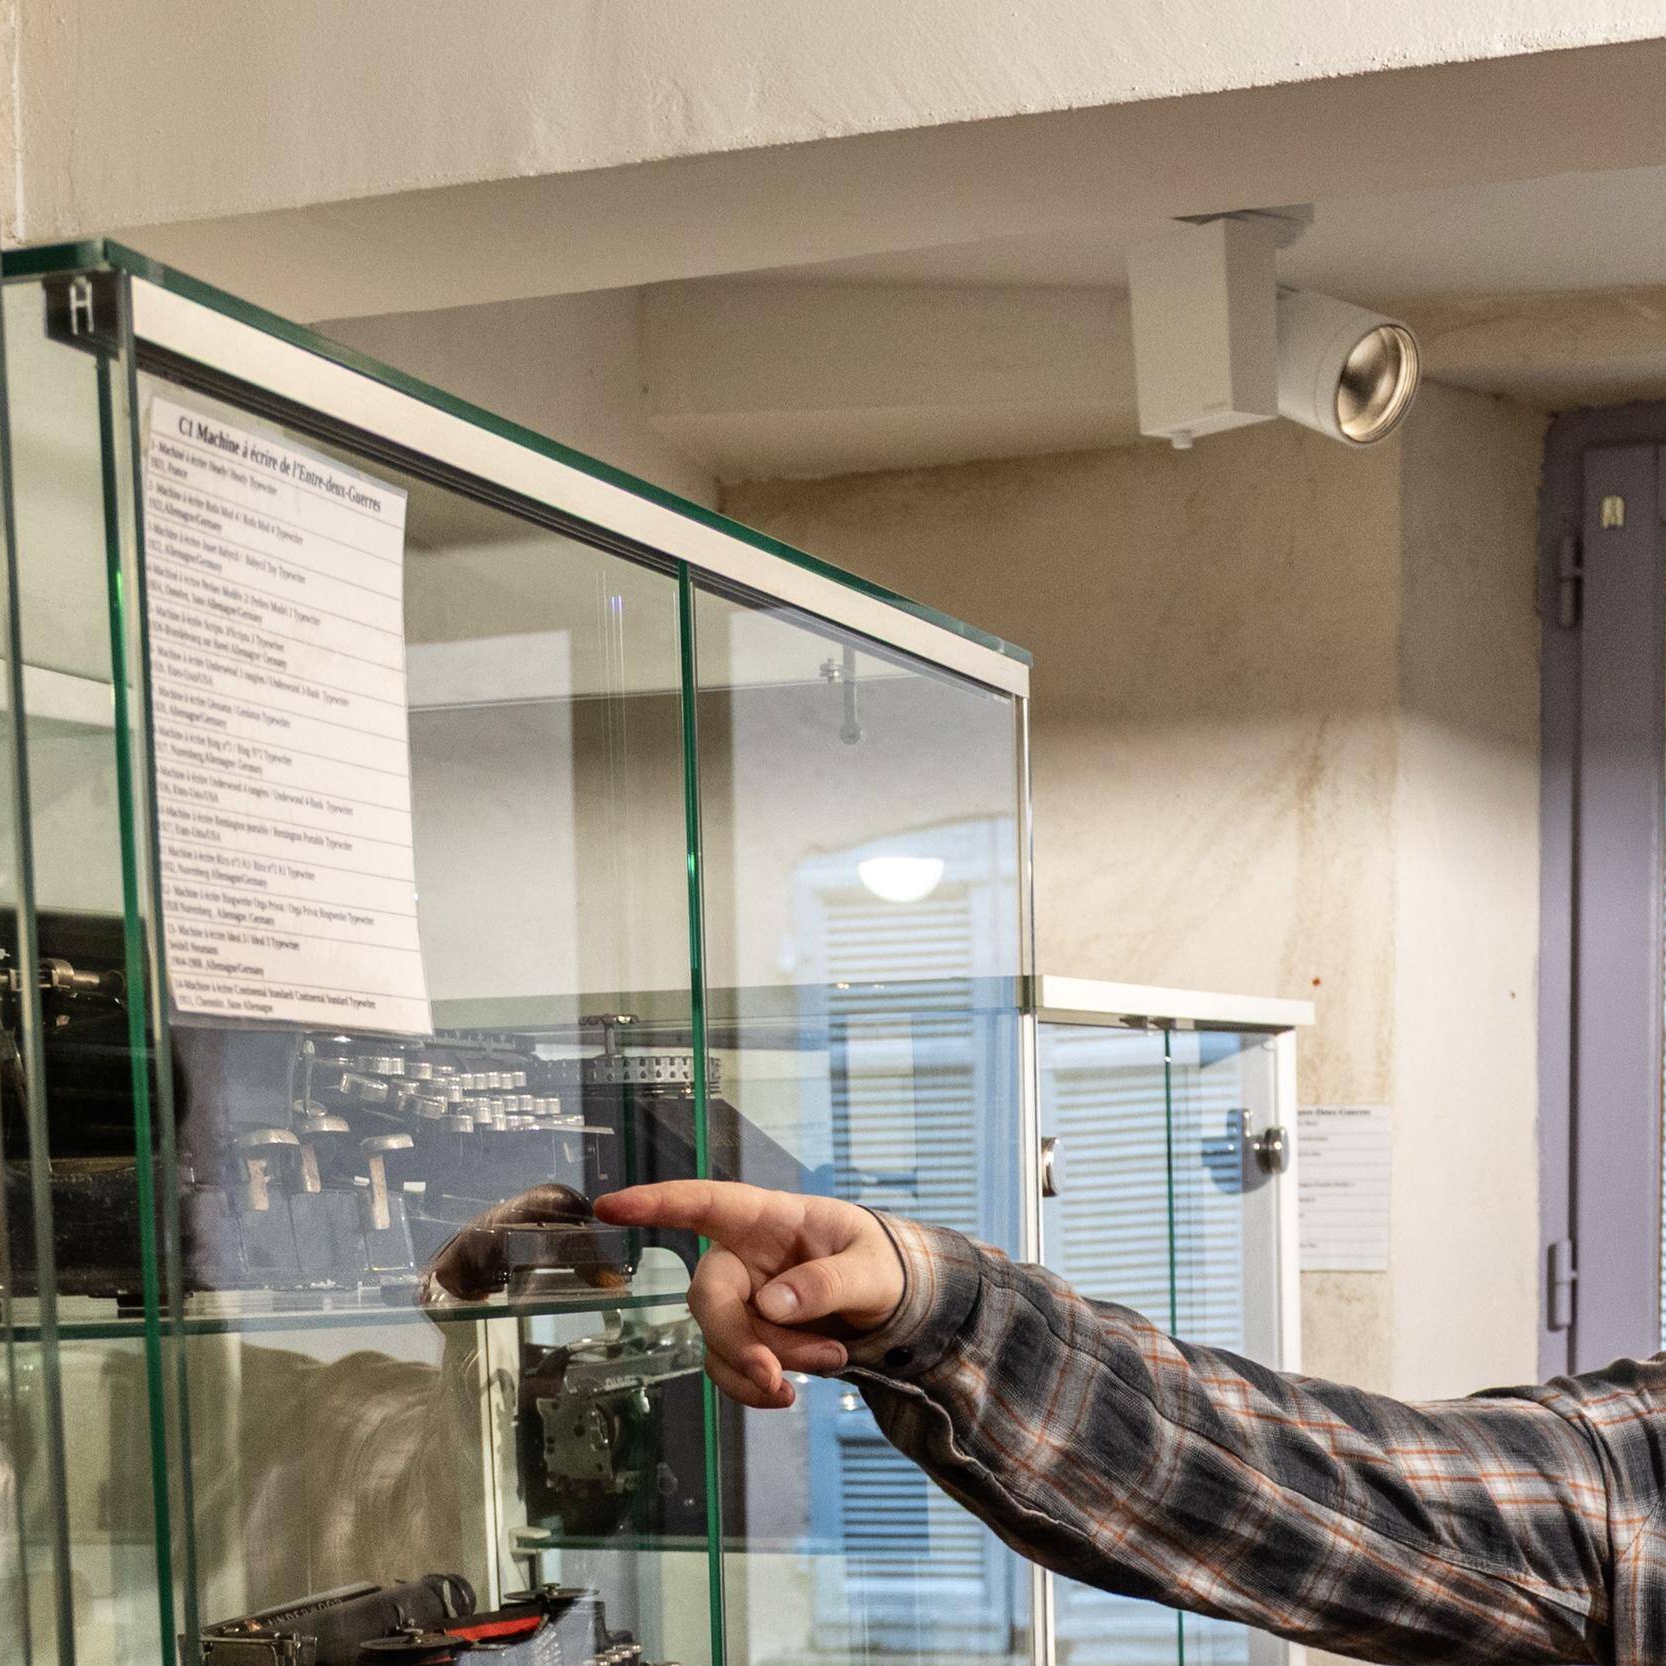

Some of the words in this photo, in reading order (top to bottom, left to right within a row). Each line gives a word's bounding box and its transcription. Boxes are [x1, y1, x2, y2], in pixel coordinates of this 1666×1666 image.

[178, 416, 193, 436] C1
[197, 423, 239, 455] Machine
[242, 441, 248, 458] à
[250, 445, 276, 469] écrire
[279, 456, 290, 475] de
